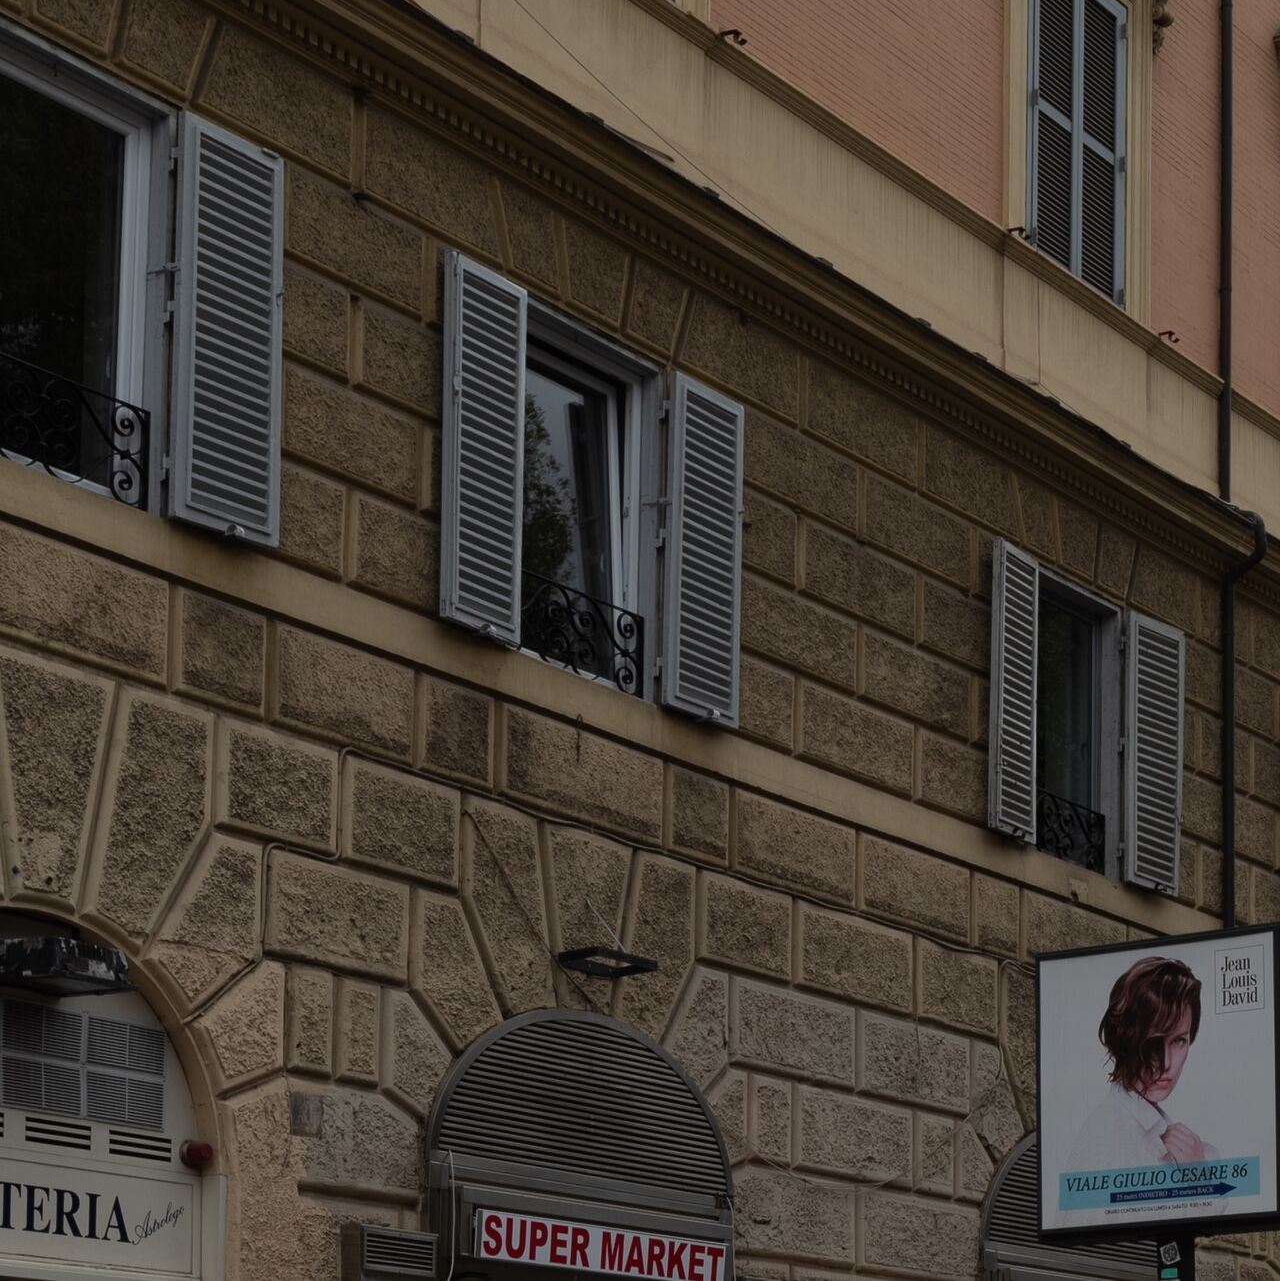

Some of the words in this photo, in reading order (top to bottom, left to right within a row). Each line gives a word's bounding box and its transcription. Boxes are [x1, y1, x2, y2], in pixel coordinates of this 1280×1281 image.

[1220, 956, 1251, 973] Jean
[1222, 970, 1258, 990] Louis
[1222, 986, 1258, 1007] David
[1066, 1175, 1110, 1192] VIALE
[1113, 1170, 1167, 1189] GIULIO
[1170, 1164, 1229, 1184] CESARE
[1231, 1163, 1249, 1179] 86
[483, 1214, 590, 1268] SUPER
[600, 1231, 724, 1281] MARKET
